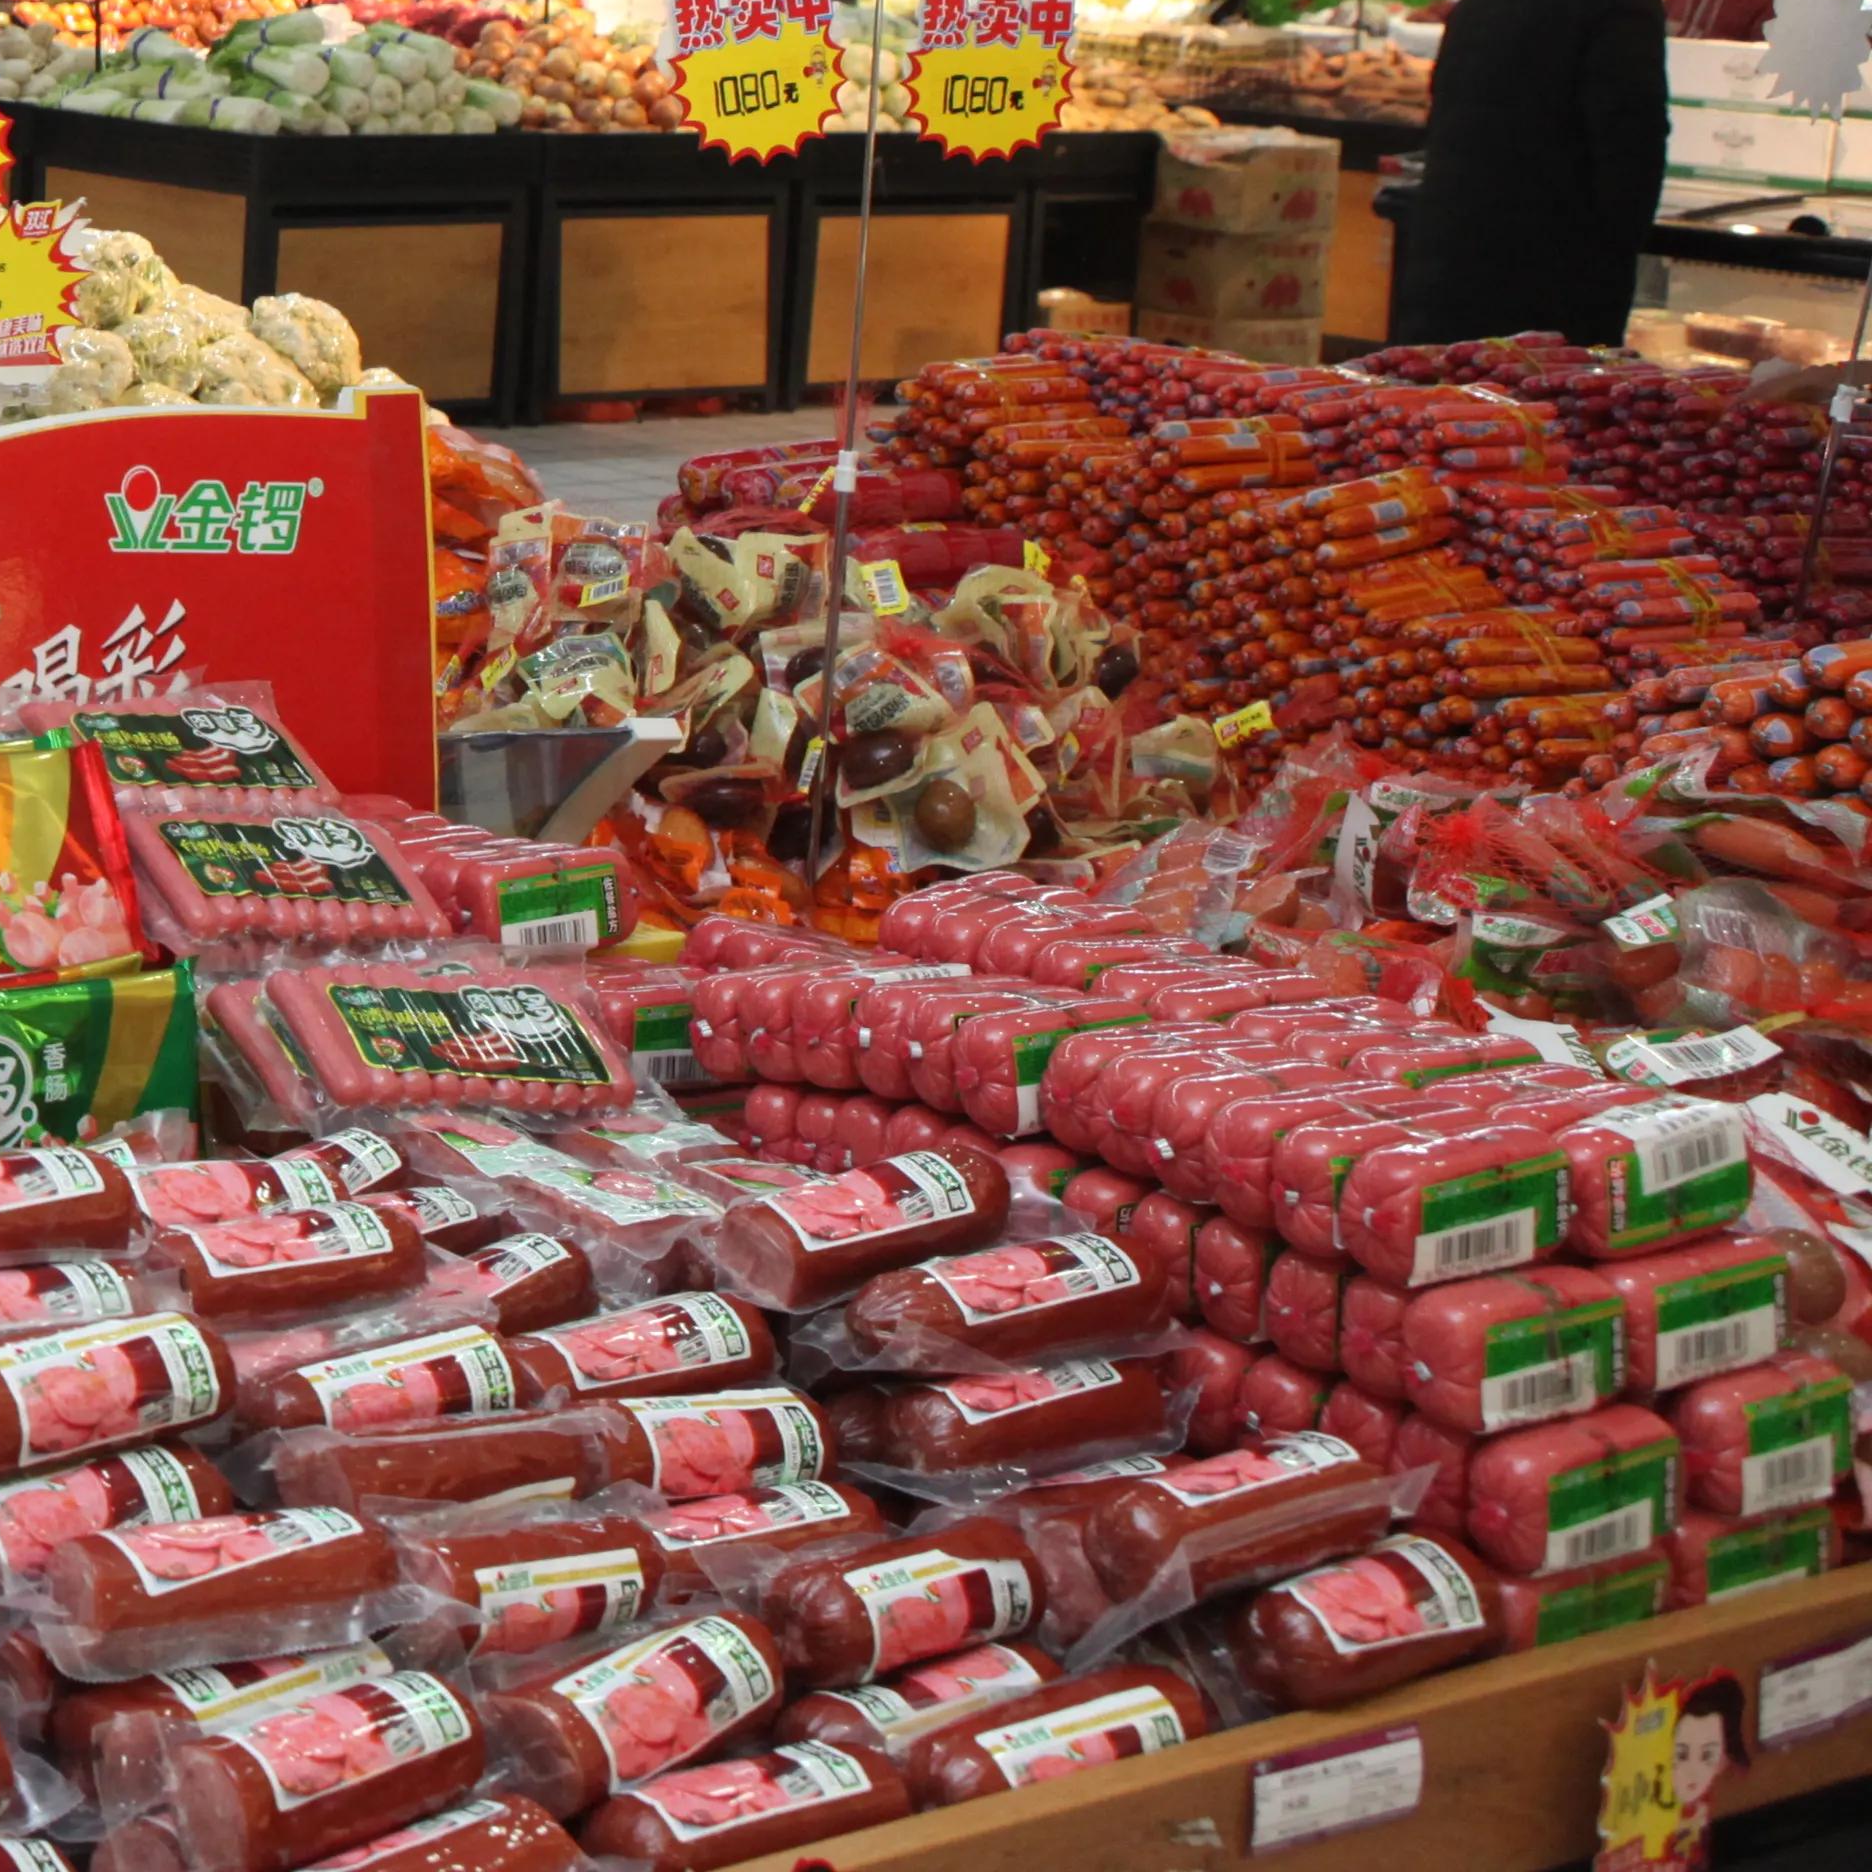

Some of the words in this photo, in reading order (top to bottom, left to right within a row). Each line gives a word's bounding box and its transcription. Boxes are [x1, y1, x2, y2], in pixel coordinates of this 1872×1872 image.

[24, 208, 54, 231] 双汇
[171, 477, 307, 556] 金锣
[44, 1040, 71, 1102] 香肠
